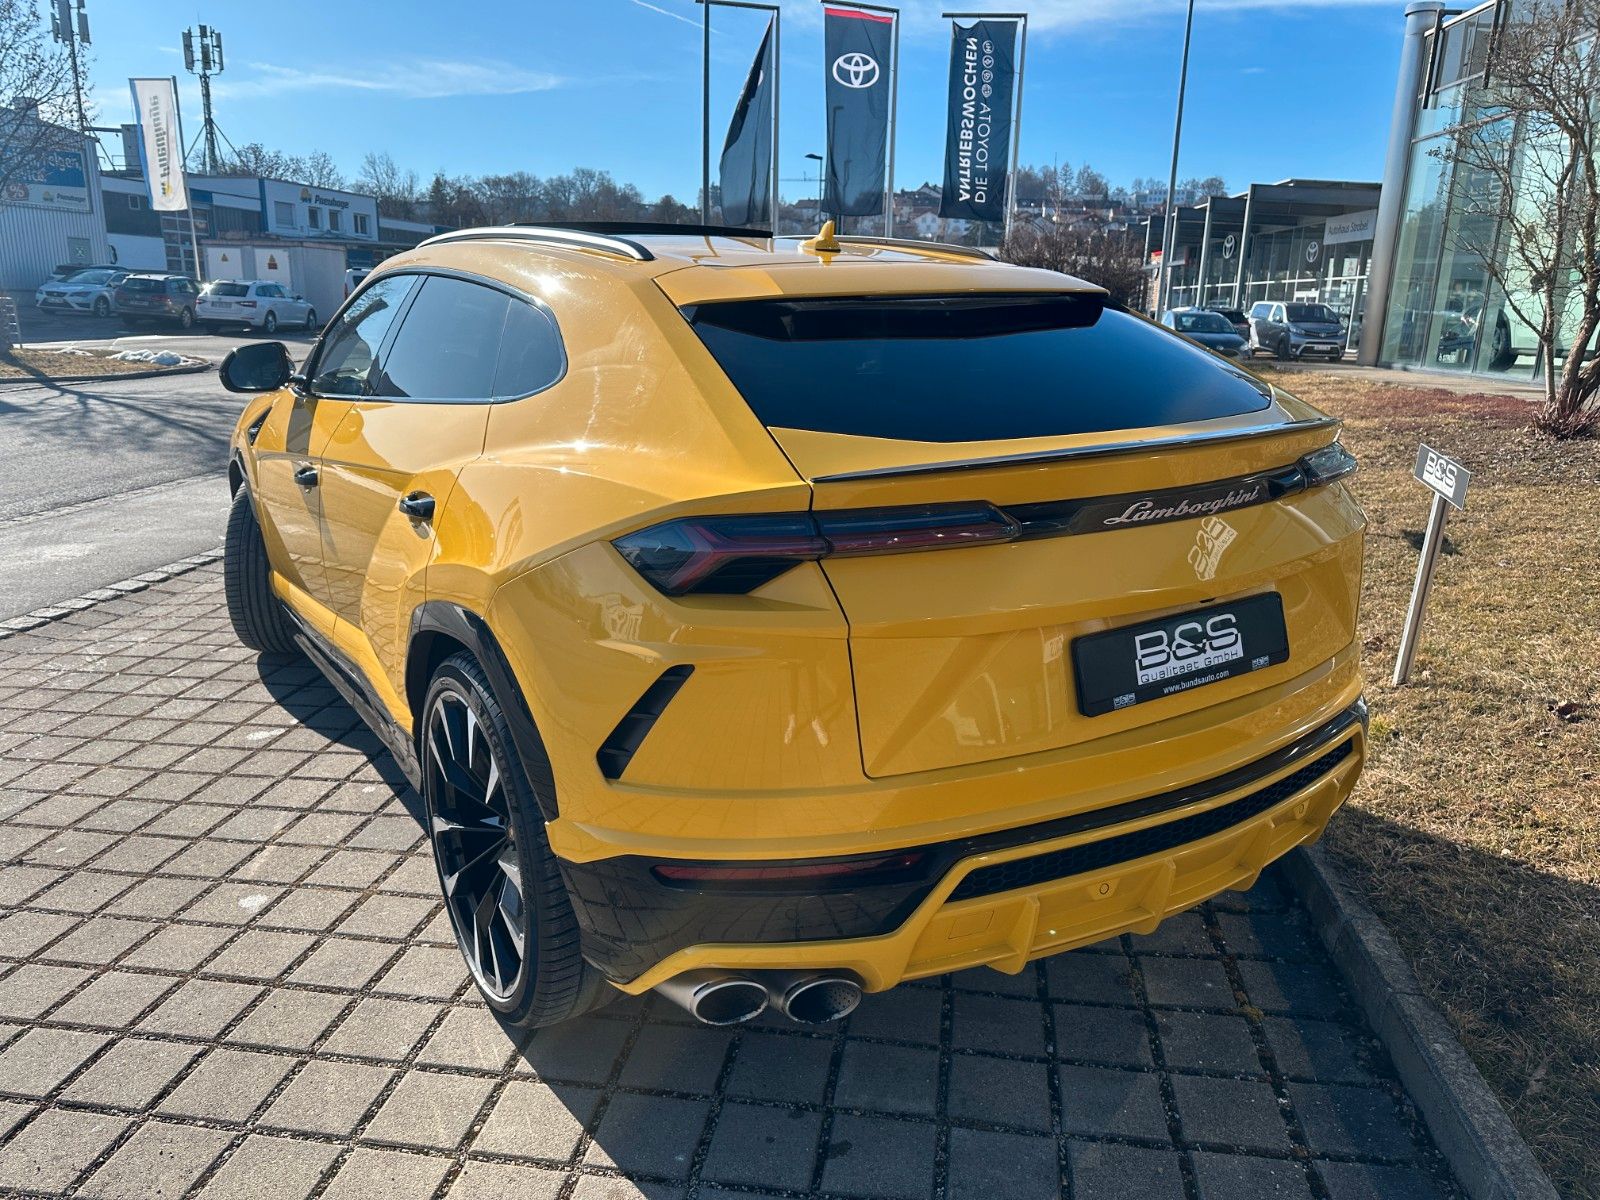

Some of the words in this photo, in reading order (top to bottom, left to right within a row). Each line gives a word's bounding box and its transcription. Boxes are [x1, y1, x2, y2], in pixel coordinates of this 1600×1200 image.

[314, 194, 350, 210] Pneuhage
[1327, 223, 1350, 236] Autohaus
[1424, 451, 1458, 489] B&S
[1103, 485, 1260, 525] Lamborghini
[1134, 613, 1240, 672] B&S
[1140, 660, 1200, 684] Qualitaet
[1204, 649, 1240, 667] GmbH
[1162, 669, 1230, 695] www.bundsauto.com
